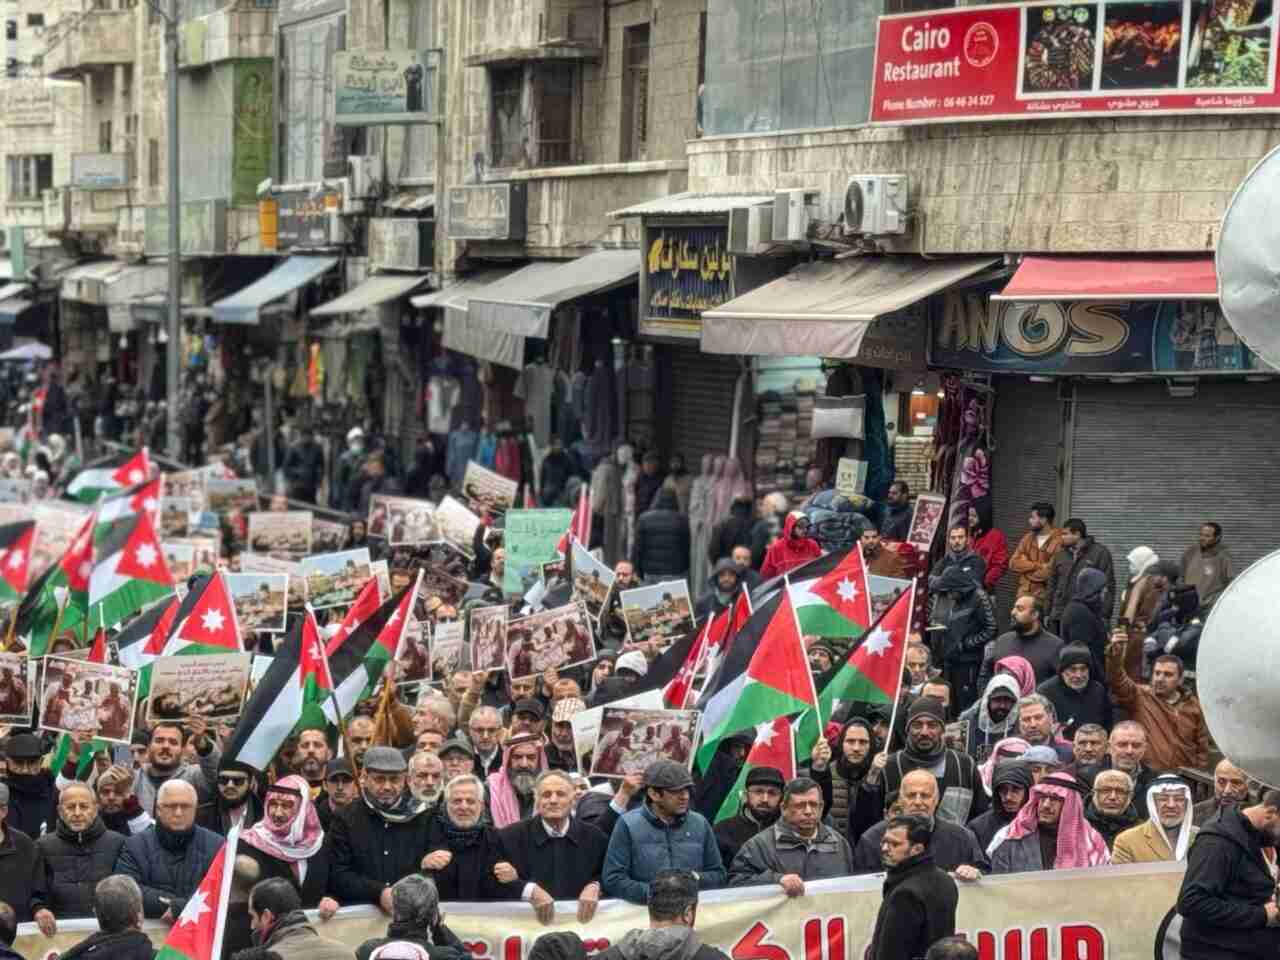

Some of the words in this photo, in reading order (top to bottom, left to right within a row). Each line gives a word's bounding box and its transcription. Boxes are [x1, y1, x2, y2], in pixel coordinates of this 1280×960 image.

[901, 22, 950, 52] Cairo
[884, 56, 960, 82] Restaurant
[883, 99, 904, 111] Phone
